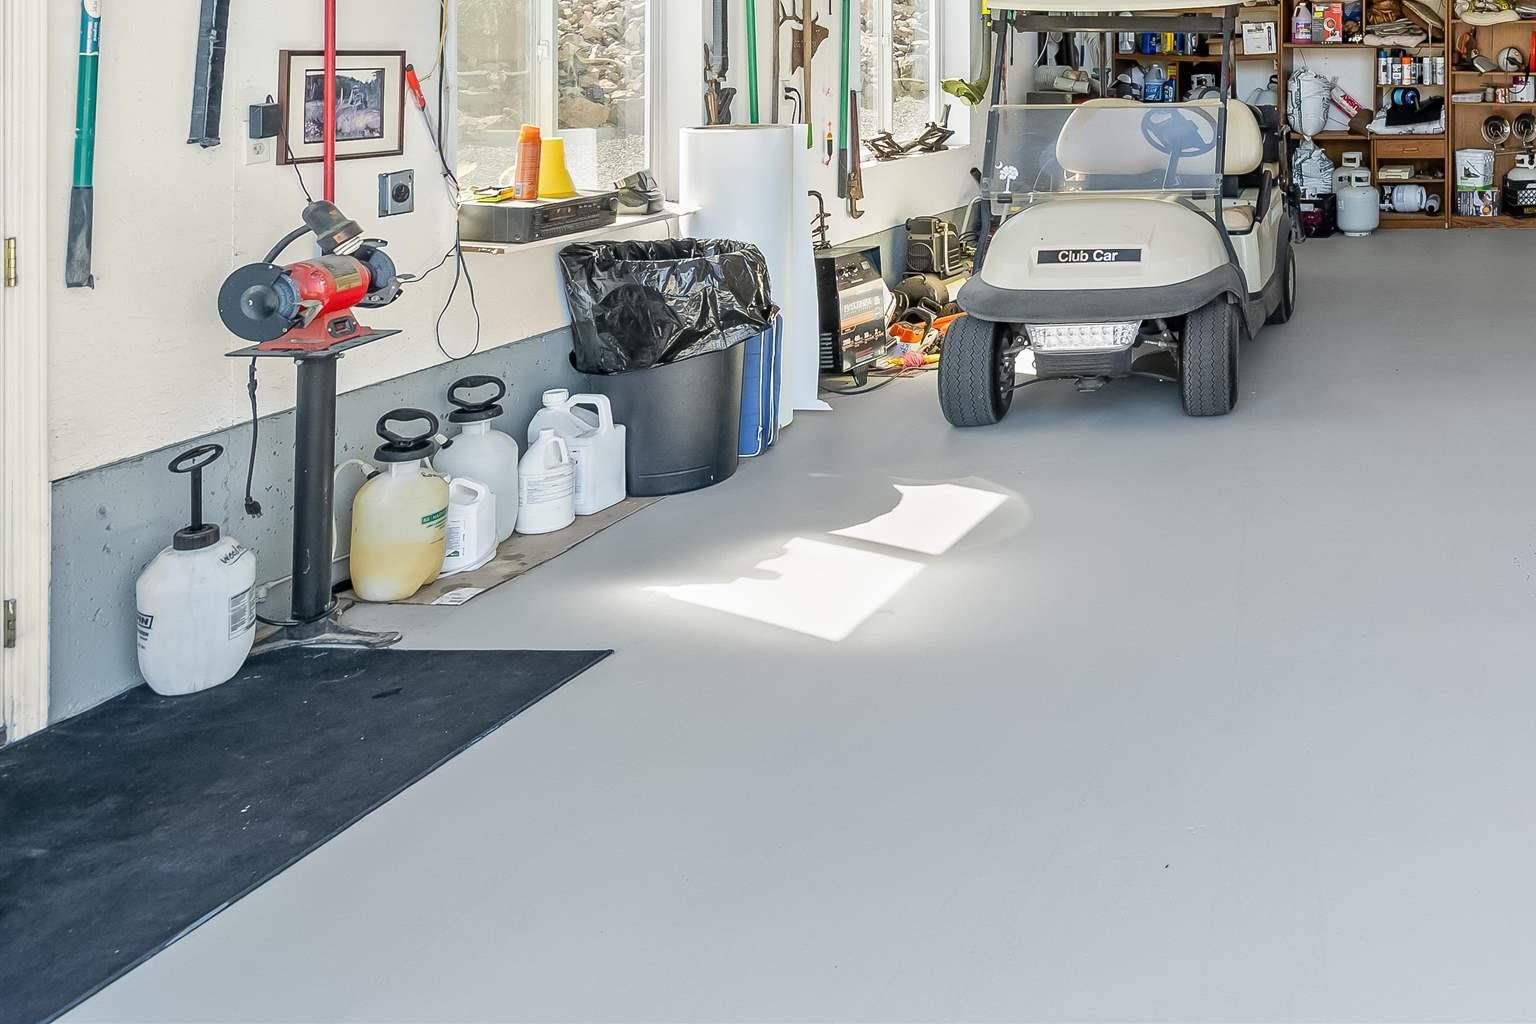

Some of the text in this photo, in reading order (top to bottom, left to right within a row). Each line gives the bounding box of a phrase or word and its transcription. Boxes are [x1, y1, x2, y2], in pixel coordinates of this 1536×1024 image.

[1341, 94, 1361, 112] USKY
[1058, 249, 1119, 262] Club Car
